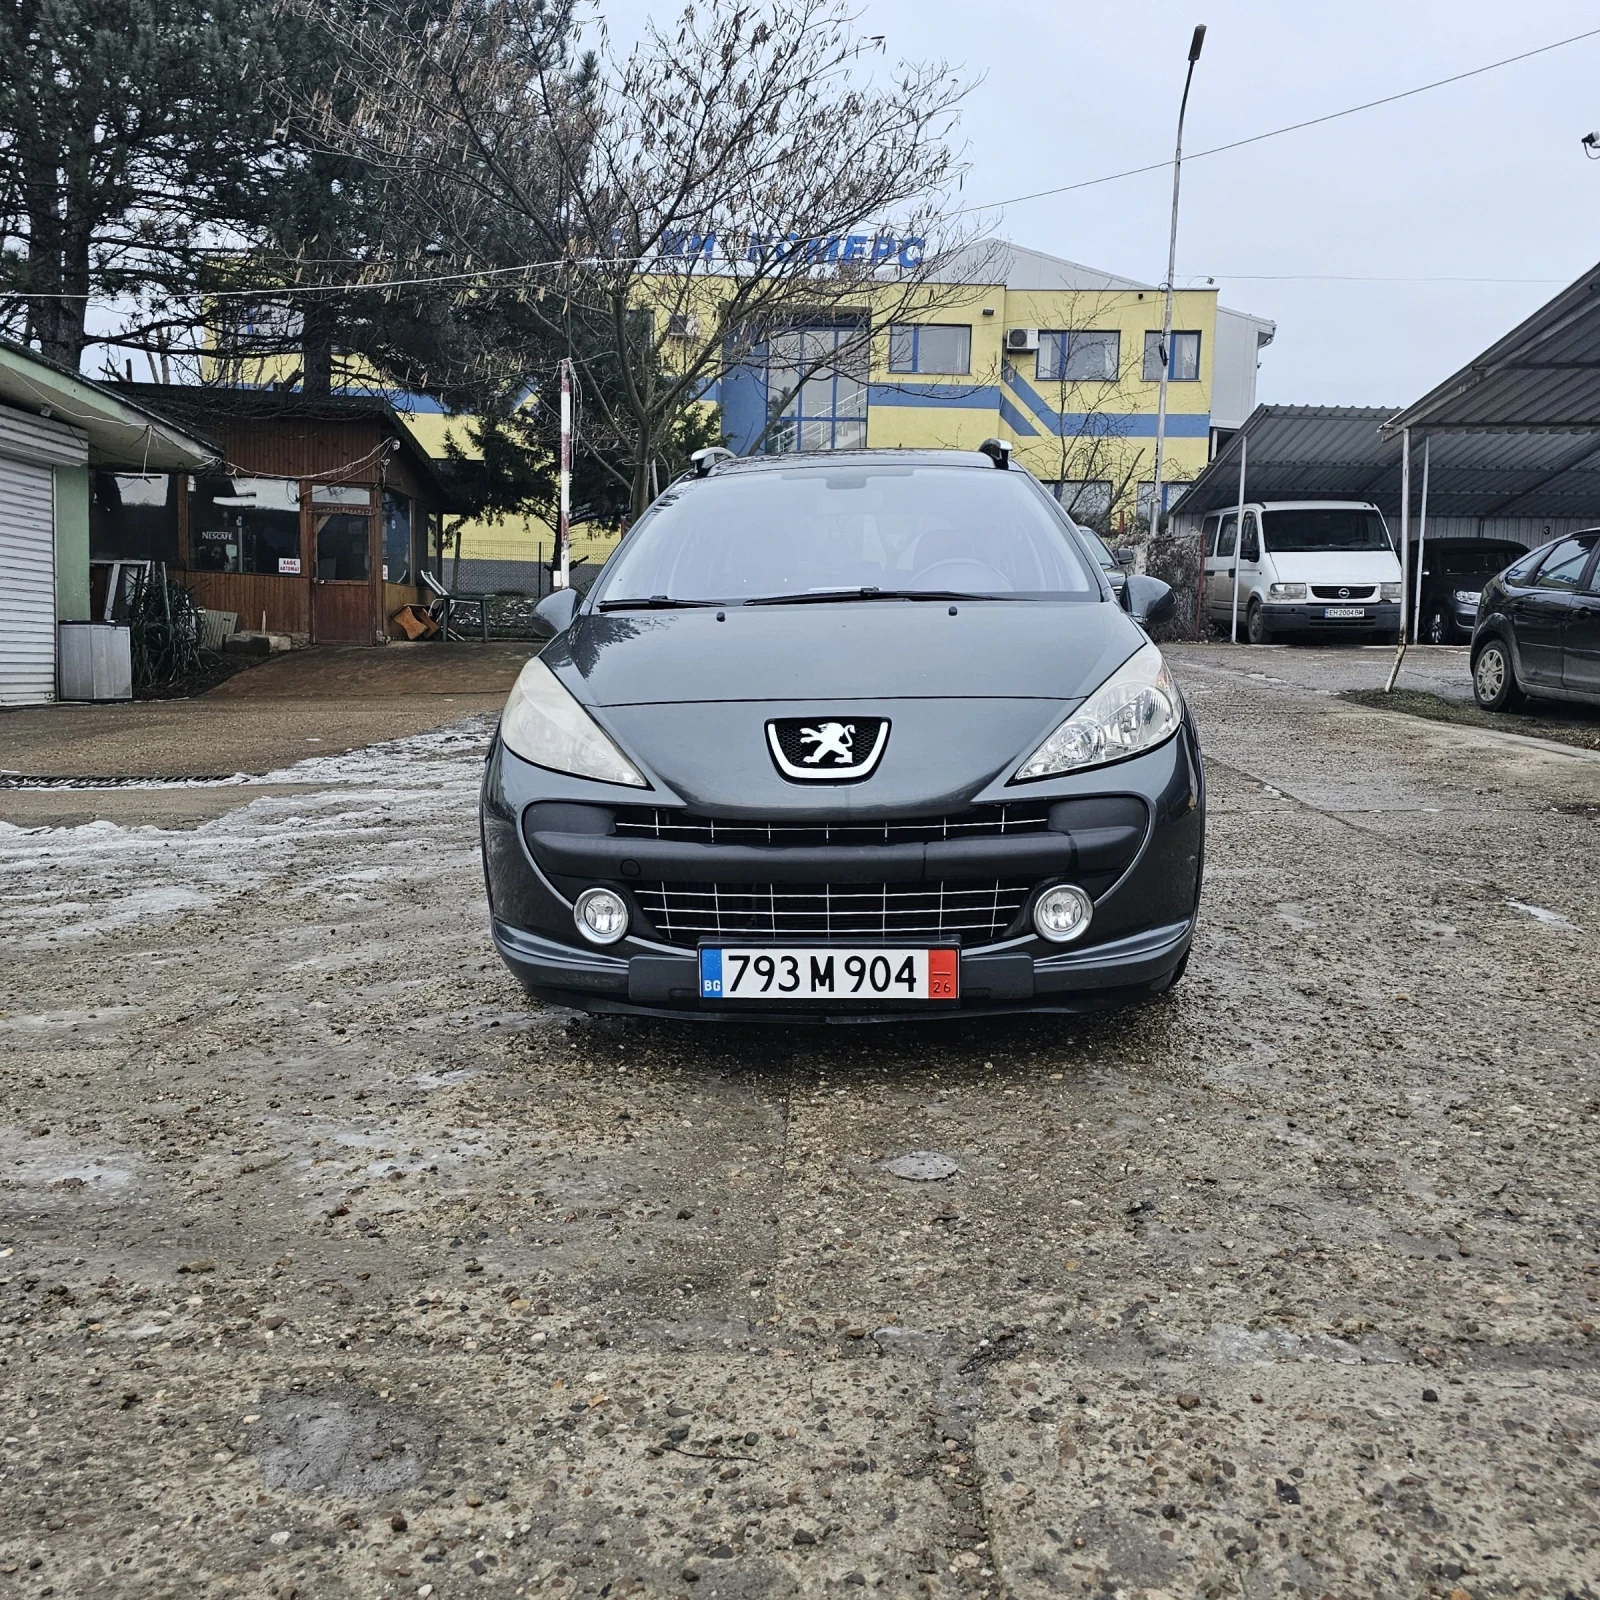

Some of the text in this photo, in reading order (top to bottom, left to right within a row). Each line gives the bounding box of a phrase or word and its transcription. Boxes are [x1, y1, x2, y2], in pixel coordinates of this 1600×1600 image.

[1543, 525, 1551, 536] 3
[728, 955, 917, 993] 793 M 904
[704, 979, 721, 992] BG
[933, 980, 951, 994] 26
